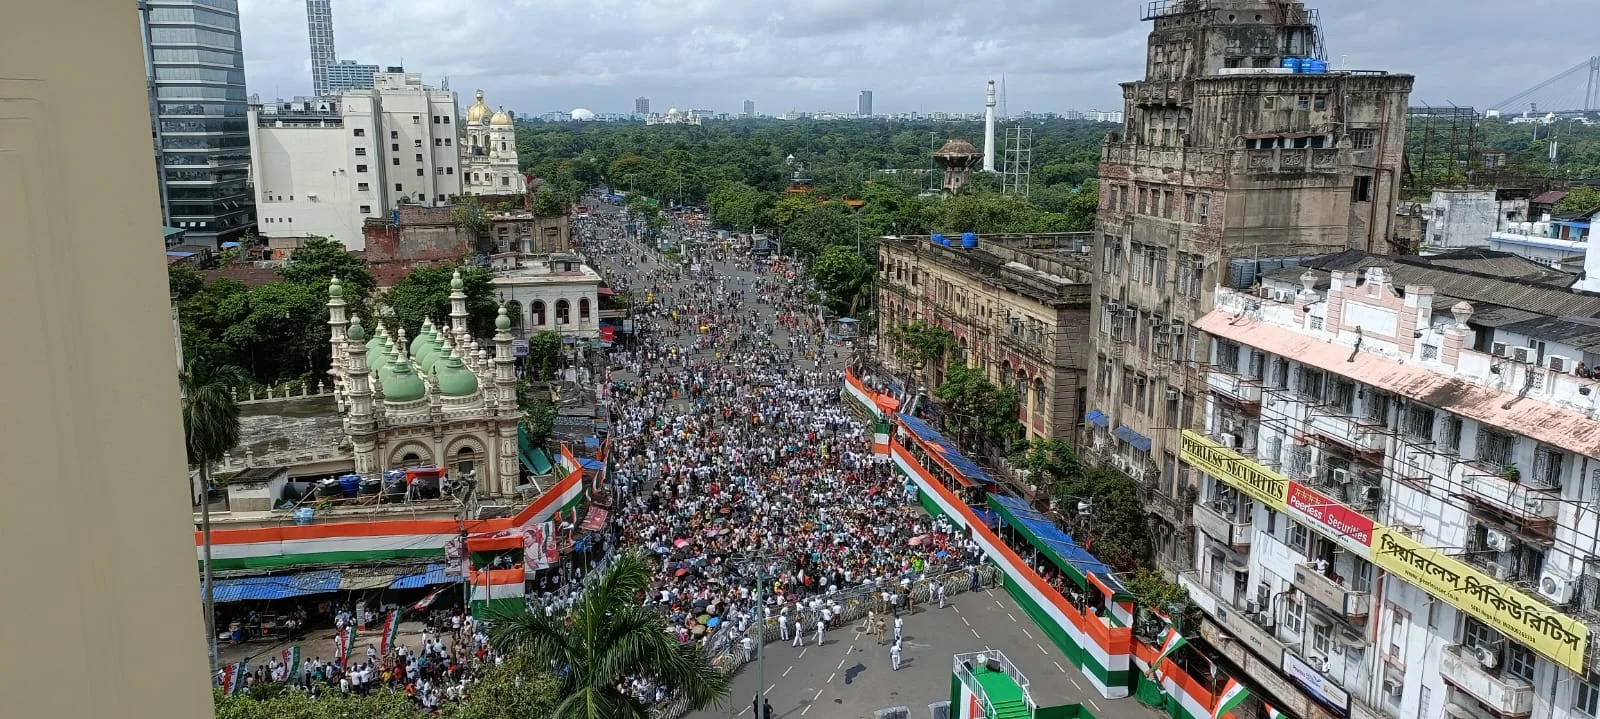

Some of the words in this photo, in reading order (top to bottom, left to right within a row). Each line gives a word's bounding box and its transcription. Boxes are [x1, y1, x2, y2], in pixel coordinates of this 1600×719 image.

[1182, 437, 1223, 468] PEERLESS
[1226, 459, 1285, 499] SECURITIES
[1290, 496, 1323, 519] Peerless
[1327, 514, 1368, 543] Securities
[1381, 534, 1461, 588] পিয়ারলেস
[1465, 576, 1581, 651] সিকিউরিটিস
